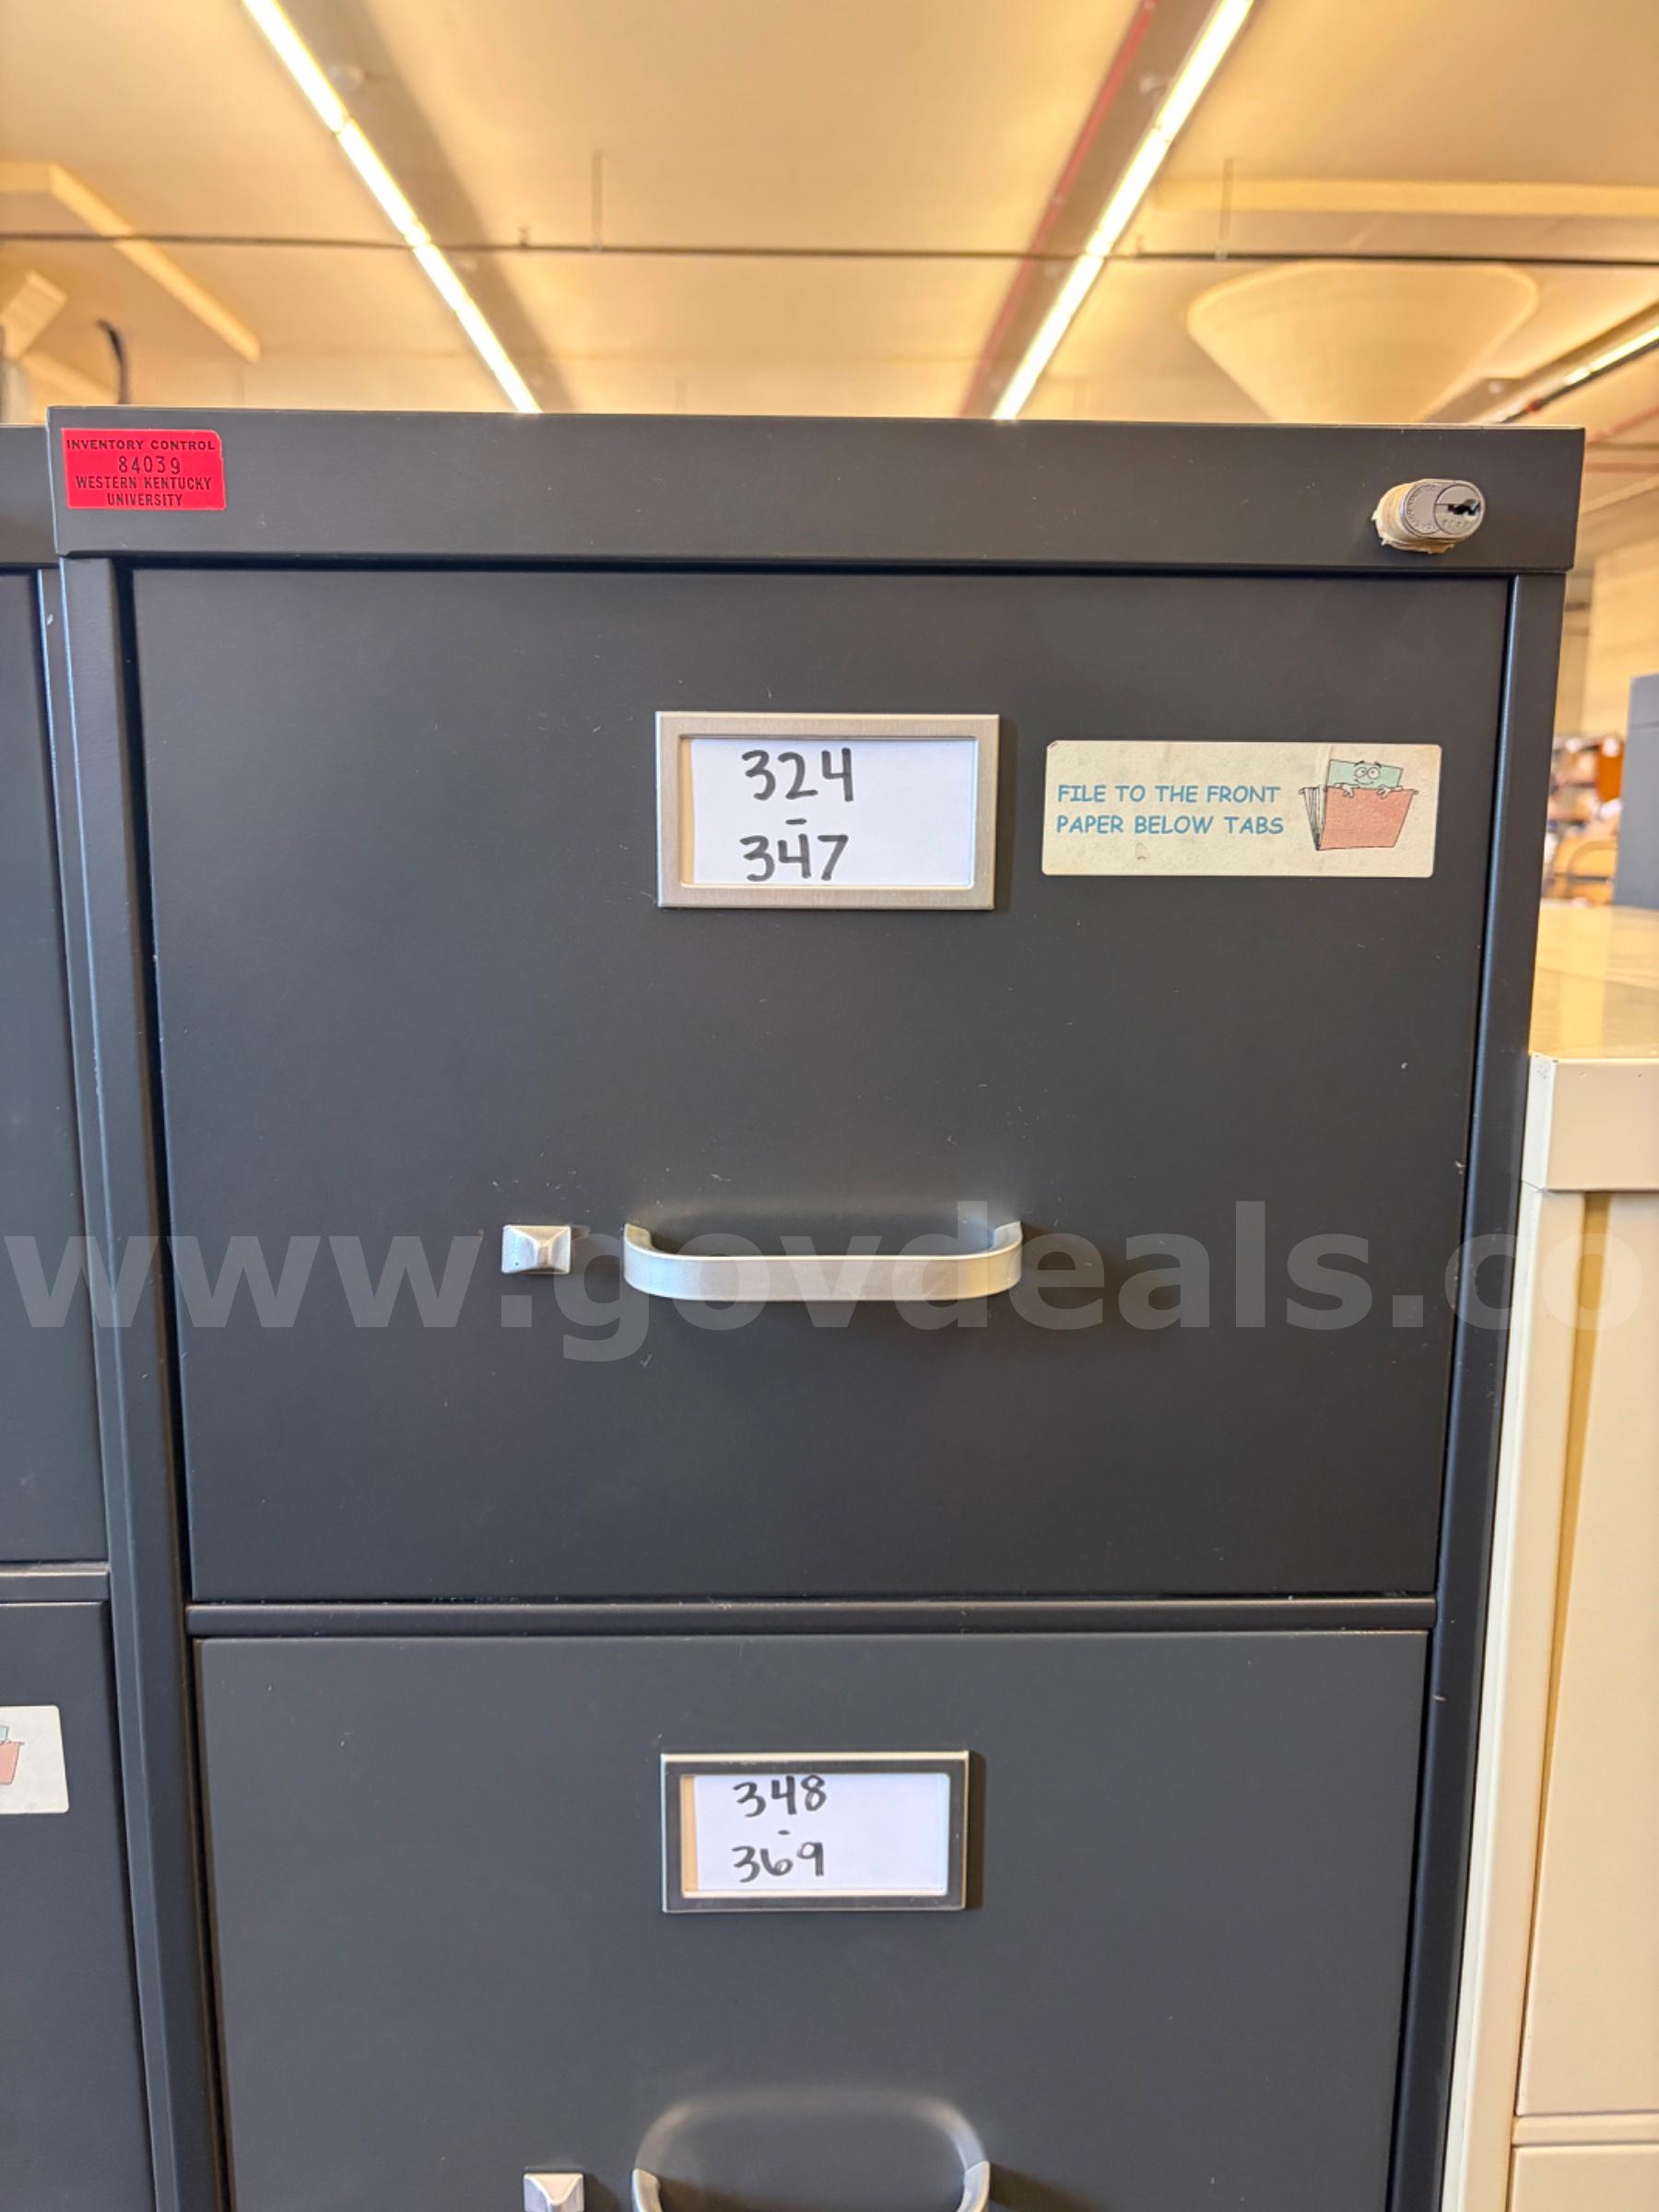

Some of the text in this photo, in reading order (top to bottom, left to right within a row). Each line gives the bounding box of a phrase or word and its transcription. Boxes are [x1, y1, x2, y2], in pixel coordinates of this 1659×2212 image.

[66, 440, 215, 450] INVENTORY CONTROL
[119, 455, 181, 475] 84039
[76, 476, 211, 490] WESTERN KENTUCKY
[107, 493, 182, 506] UNIVERSITY
[741, 747, 853, 802] 324
[1057, 785, 1280, 803] FILE TO THE FRONT
[1056, 815, 1284, 835] PAPER BELOW TABS
[739, 833, 849, 882] 347
[733, 1775, 827, 1818] 348
[732, 1841, 825, 1883] 369
